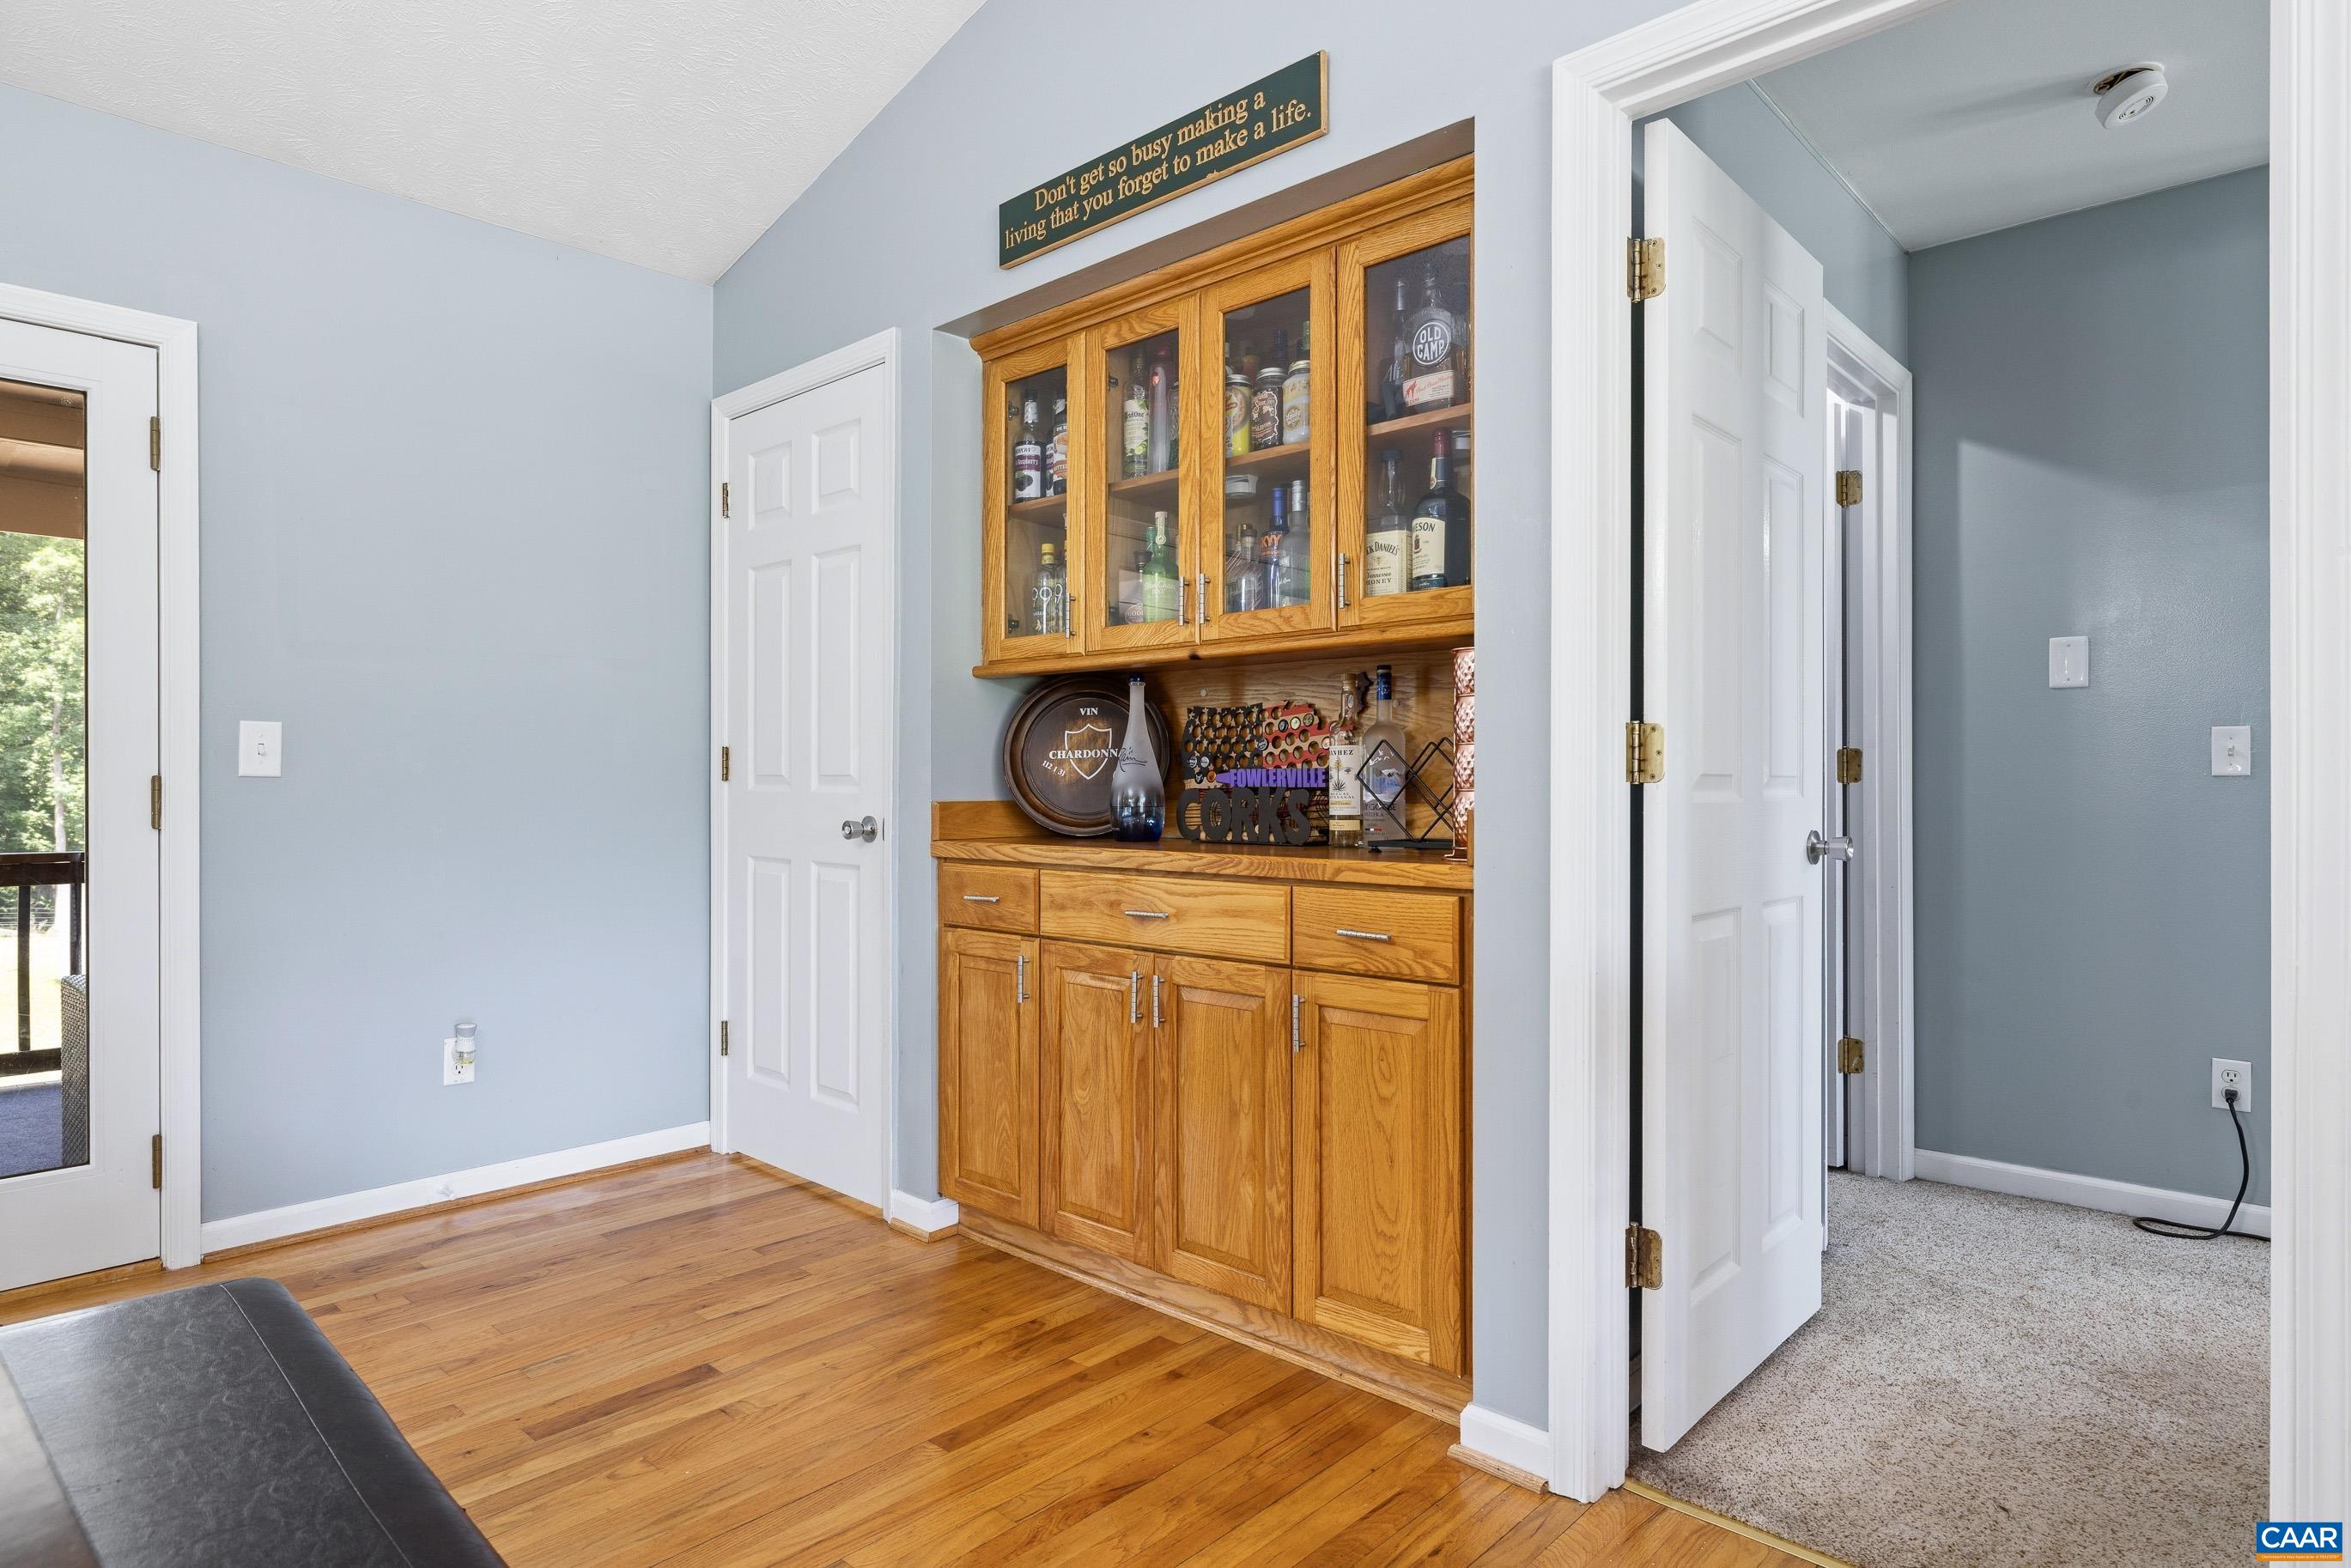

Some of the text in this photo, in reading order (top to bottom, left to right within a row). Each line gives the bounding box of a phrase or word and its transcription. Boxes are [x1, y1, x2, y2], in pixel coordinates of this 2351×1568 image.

[1034, 91, 1266, 211] Don't get so busy making a
[1005, 99, 1313, 249] living that you forget to make a life.
[1419, 326, 1442, 343] OLD
[1417, 339, 1445, 361] CAMP
[1412, 521, 1436, 532] ESON
[1261, 534, 1282, 547] KYY
[1375, 541, 1400, 556] DANIEL'S
[1079, 707, 1098, 716] VIN
[1048, 748, 1122, 760] CHARDONN
[1230, 769, 1326, 788] FOWLERVILLE
[1176, 787, 1311, 846] CORKS
